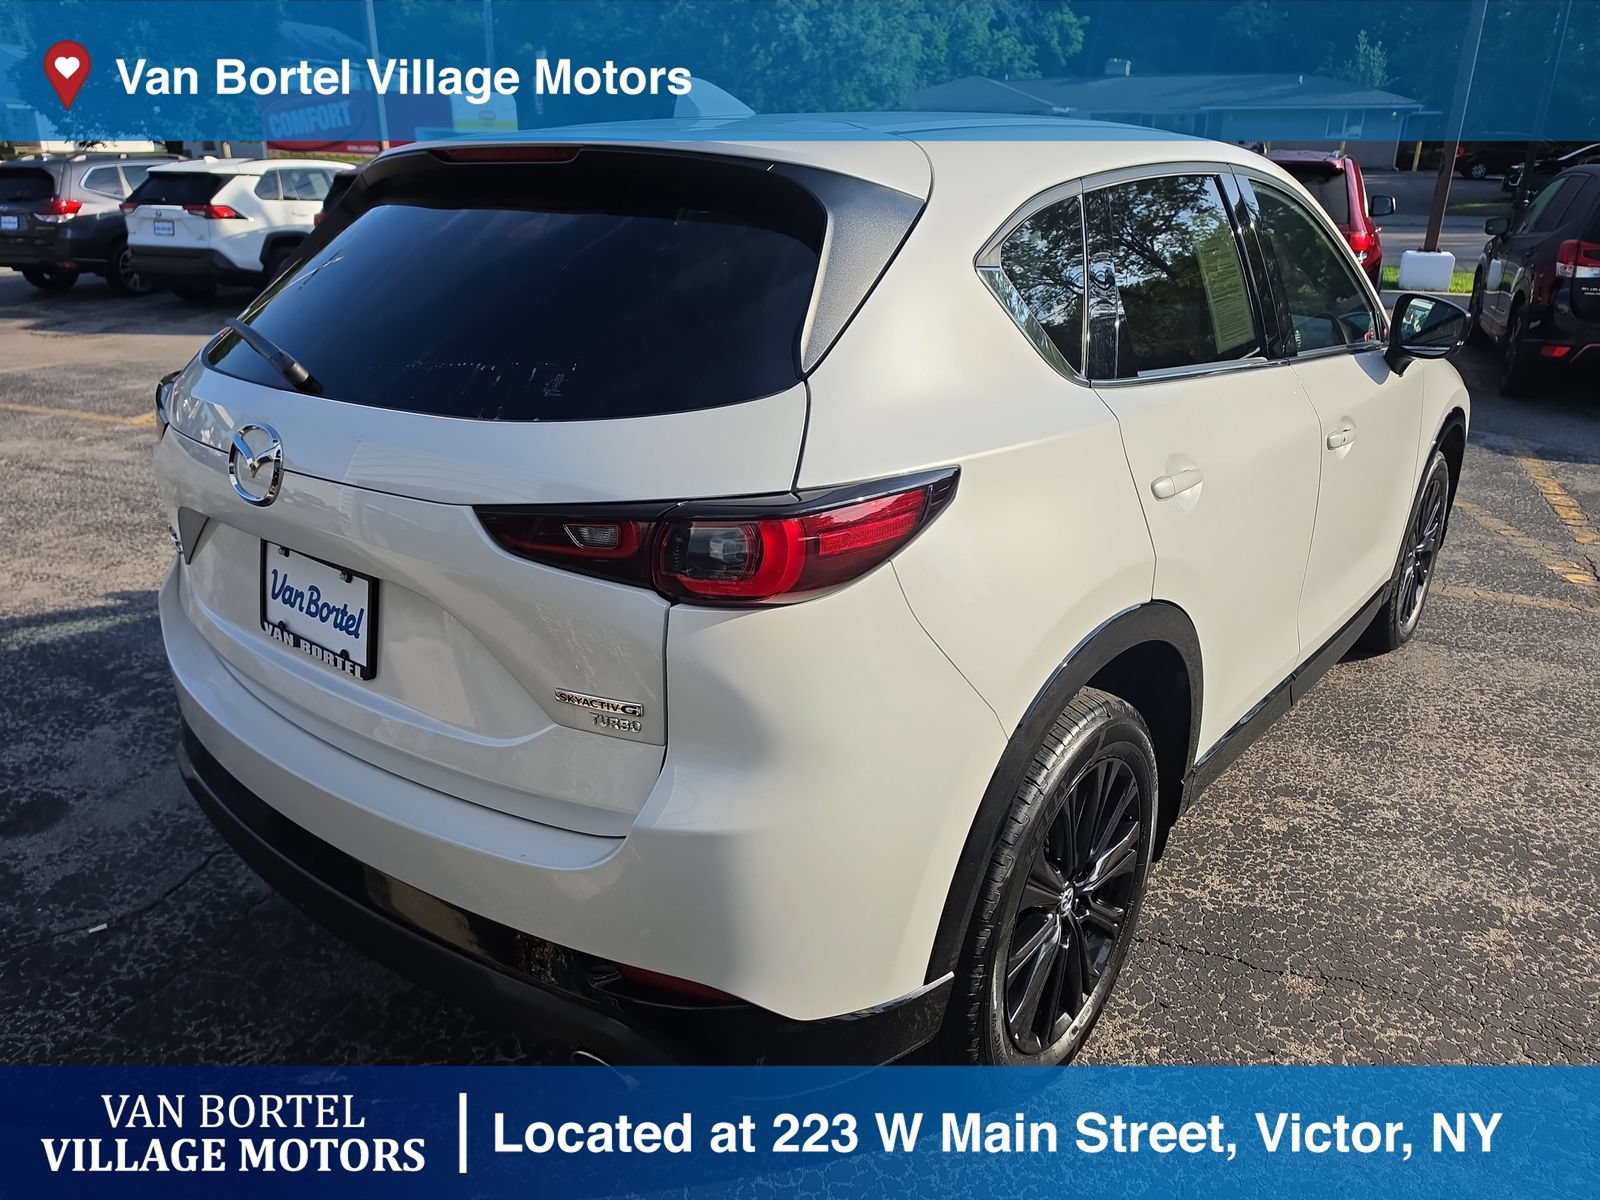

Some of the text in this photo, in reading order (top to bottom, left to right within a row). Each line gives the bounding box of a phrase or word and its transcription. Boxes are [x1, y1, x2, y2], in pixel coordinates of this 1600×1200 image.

[268, 100, 351, 138] COMFORT
[271, 568, 365, 639] Van Bortel
[263, 621, 364, 680] VAN BORTEL
[589, 711, 642, 733] TURBO
